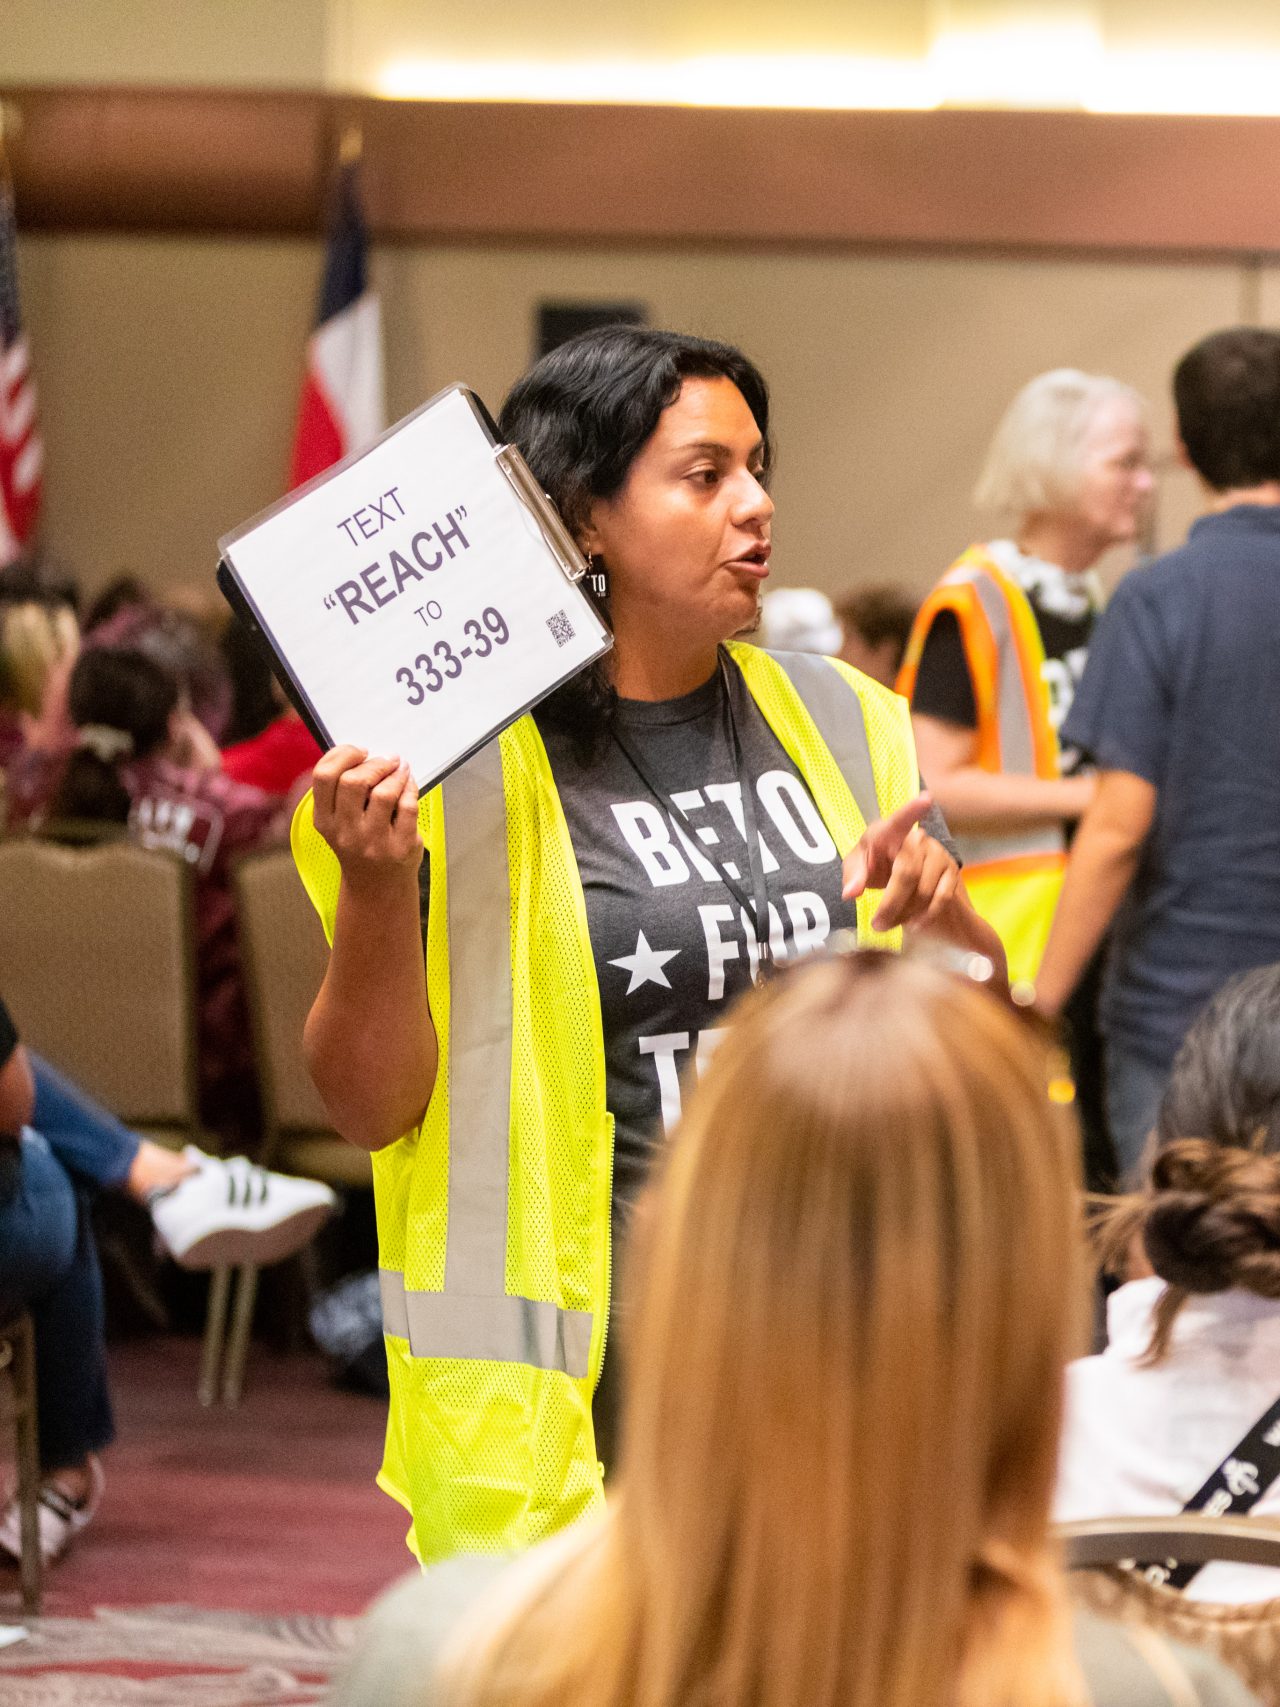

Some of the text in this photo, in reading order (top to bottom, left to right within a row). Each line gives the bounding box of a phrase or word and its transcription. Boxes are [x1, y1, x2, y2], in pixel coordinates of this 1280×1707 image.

[323, 505, 471, 625] “REACH”
[336, 486, 406, 547] TEXT
[395, 606, 511, 706] 333-39
[413, 599, 443, 627] TO
[610, 770, 837, 887] BETO
